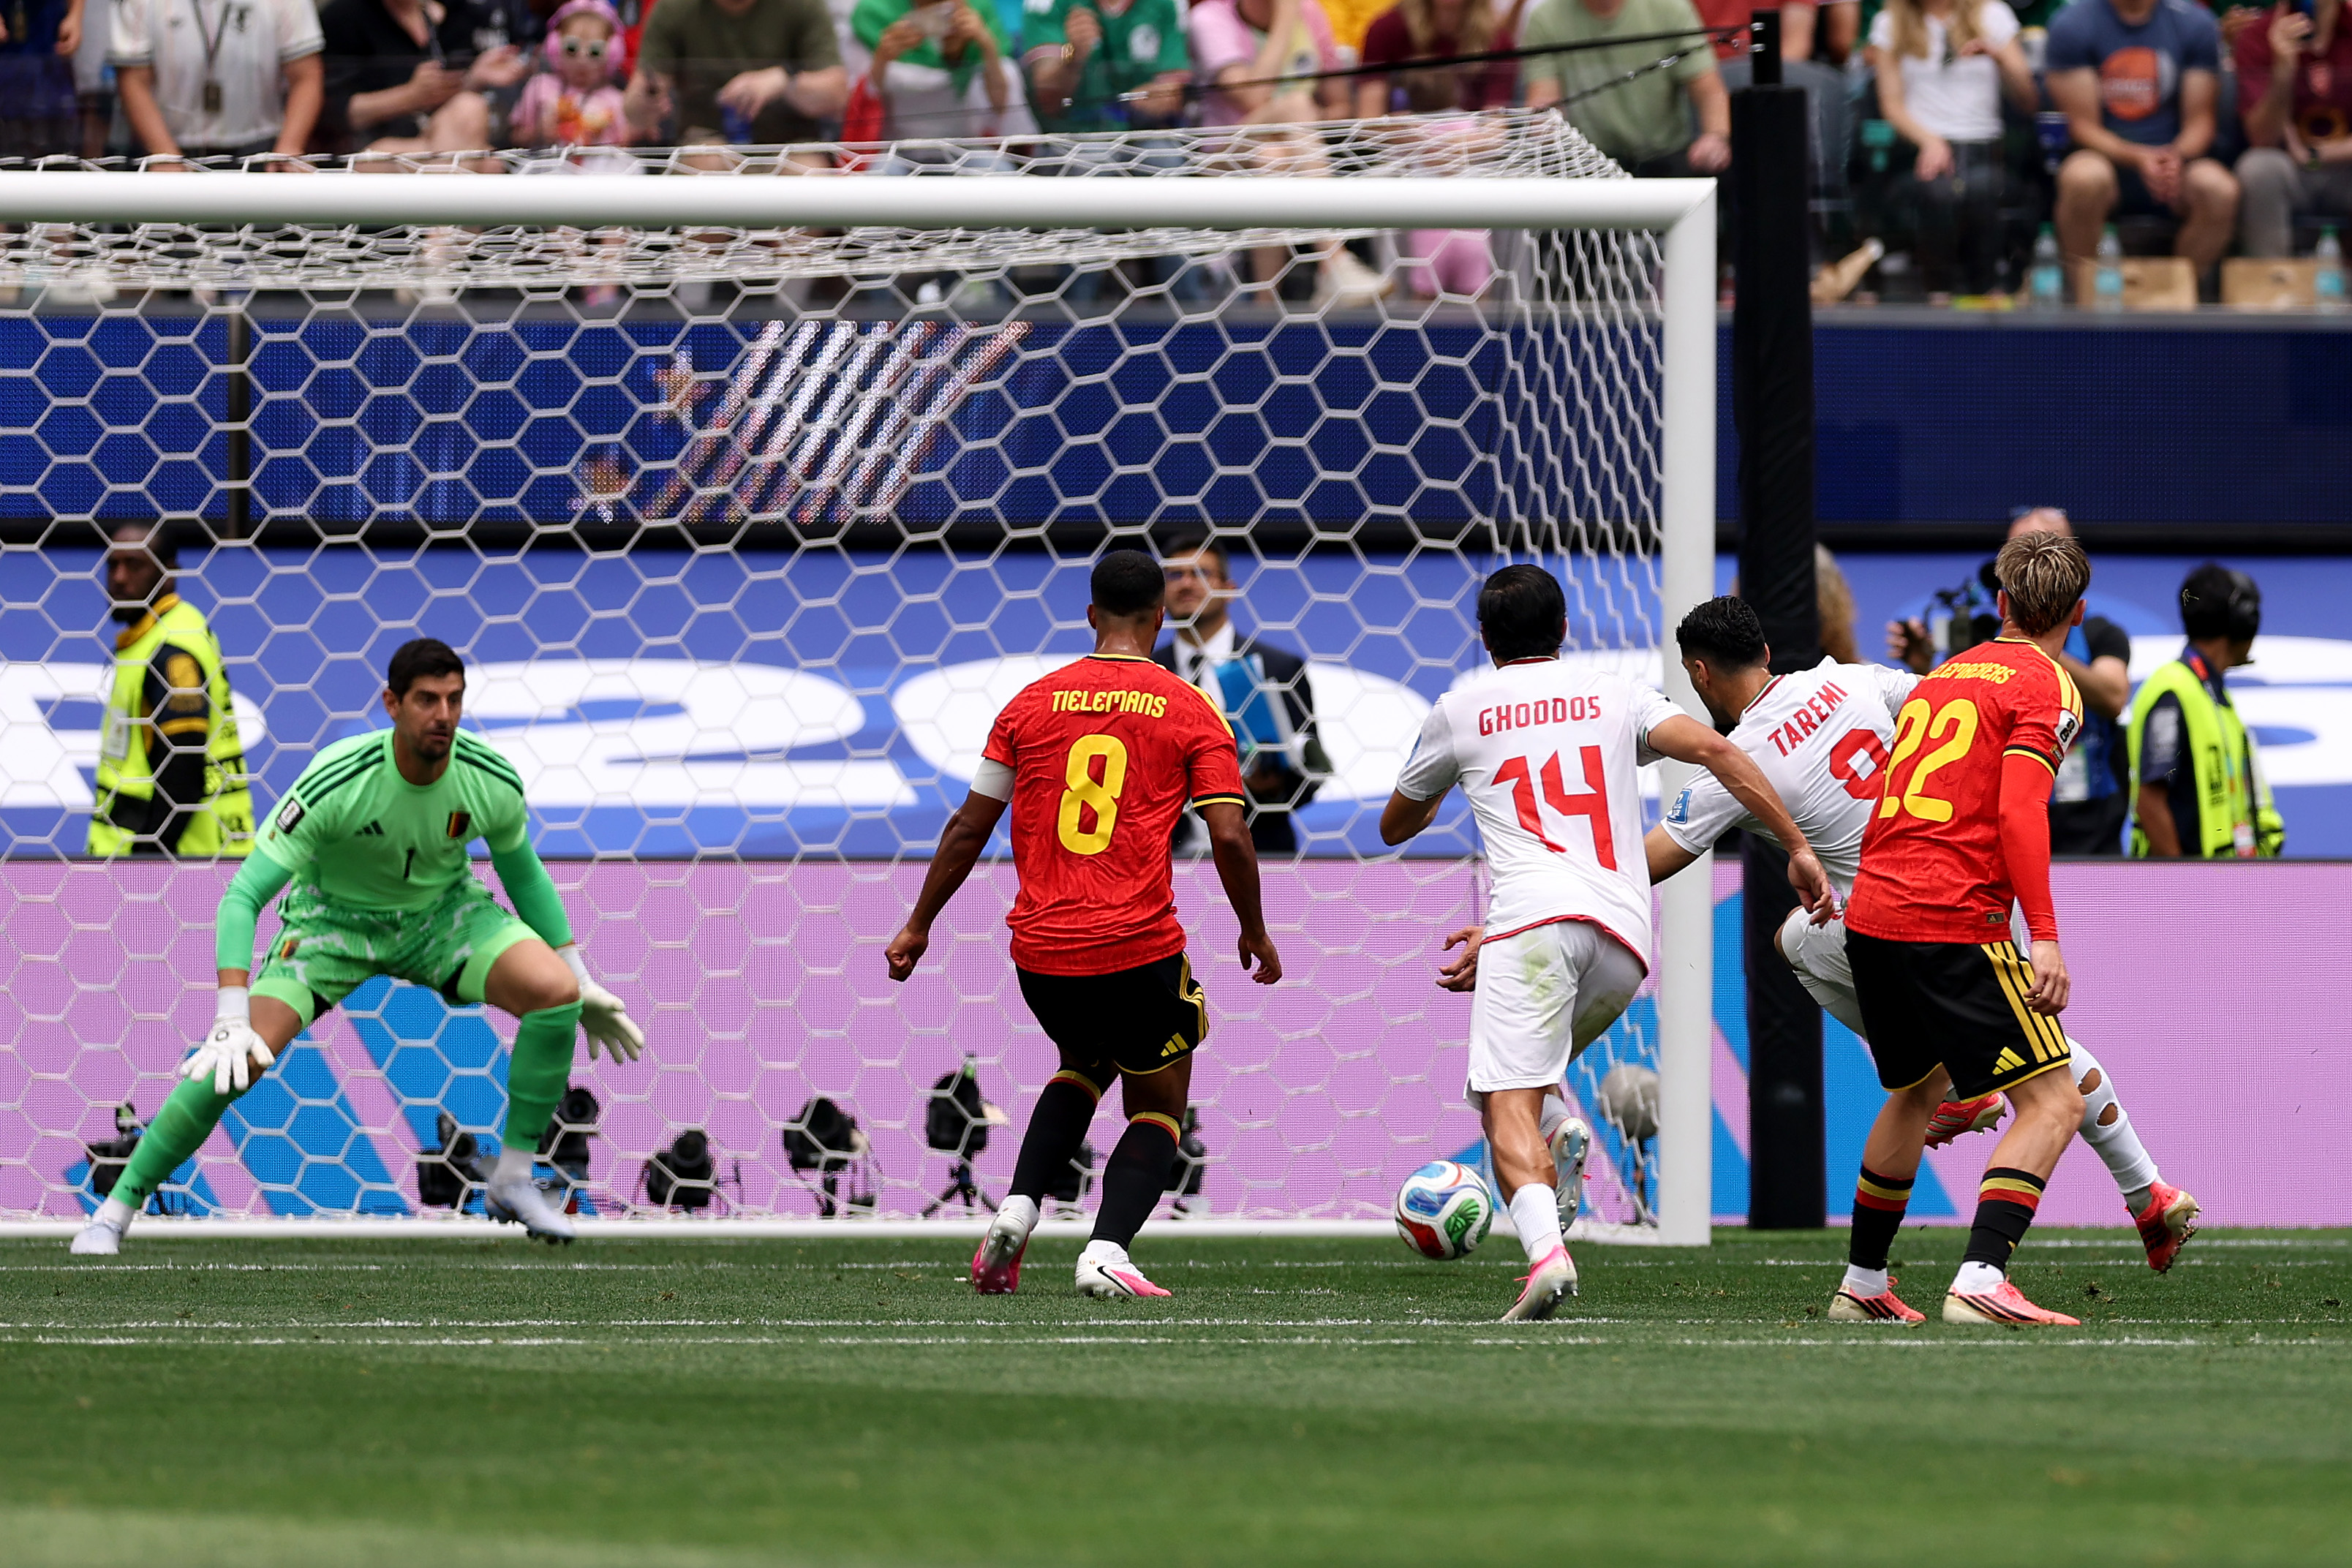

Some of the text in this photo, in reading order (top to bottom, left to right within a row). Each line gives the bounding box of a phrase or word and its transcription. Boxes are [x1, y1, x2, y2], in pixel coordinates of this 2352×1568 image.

[1051, 689, 1168, 718] TIELEMANS
[1479, 696, 1601, 736] GHODDOS
[1768, 680, 1849, 757] TAREMI
[1057, 734, 1128, 856] 8
[1878, 698, 1979, 823] 22
[1490, 745, 1617, 872] 14
[403, 848, 415, 880] 1
